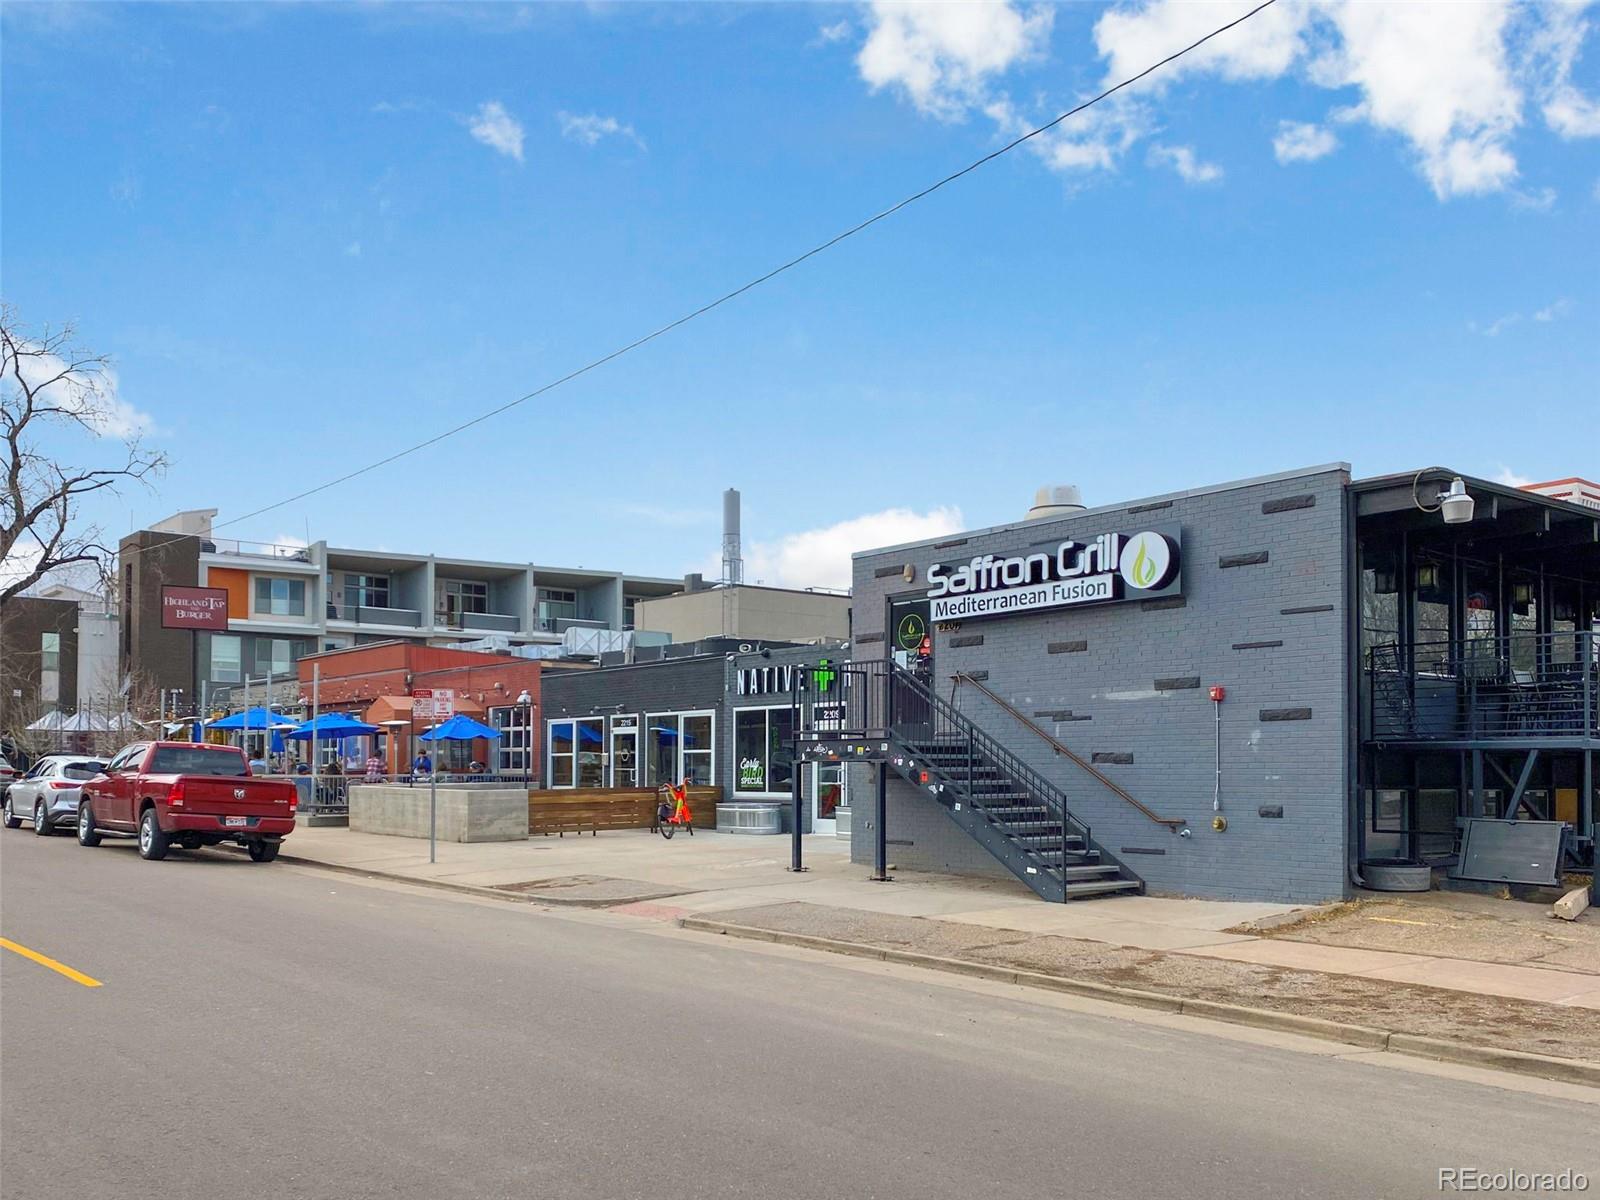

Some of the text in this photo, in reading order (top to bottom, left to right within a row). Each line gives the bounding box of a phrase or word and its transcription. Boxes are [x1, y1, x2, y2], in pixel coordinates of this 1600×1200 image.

[926, 532, 1119, 598] Saffron Grill
[934, 580, 1108, 618] Mediterranean Fusion
[737, 664, 804, 695] NATIVE
[741, 777, 764, 785] SPECIAL
[742, 766, 764, 779] BIRD
